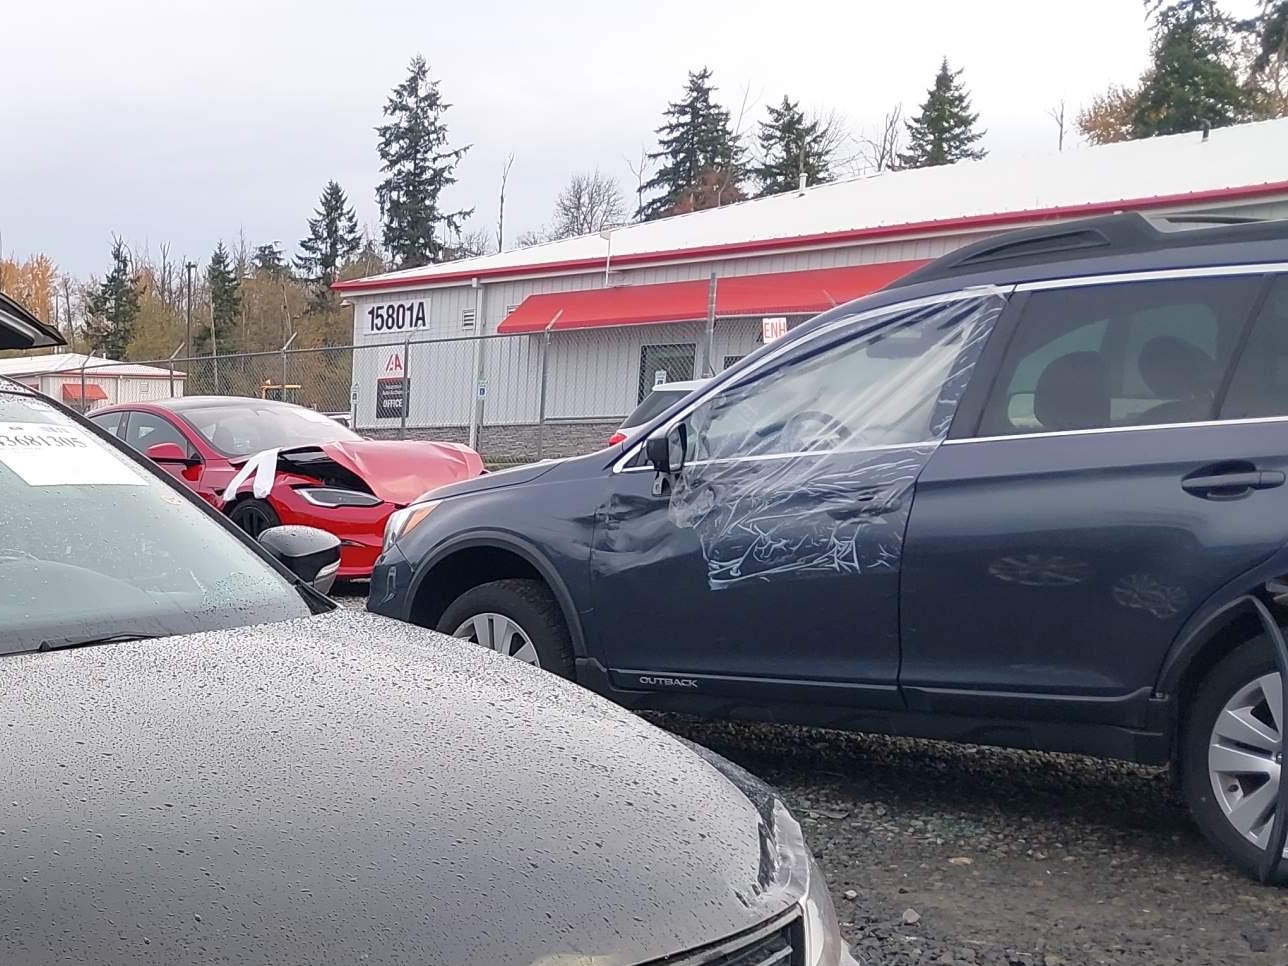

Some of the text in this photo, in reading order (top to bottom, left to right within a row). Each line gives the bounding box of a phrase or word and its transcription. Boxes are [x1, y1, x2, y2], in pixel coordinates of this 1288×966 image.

[368, 301, 426, 331] 15801A
[383, 398, 403, 408] OFFICE
[639, 676, 698, 688] OUTBACK
